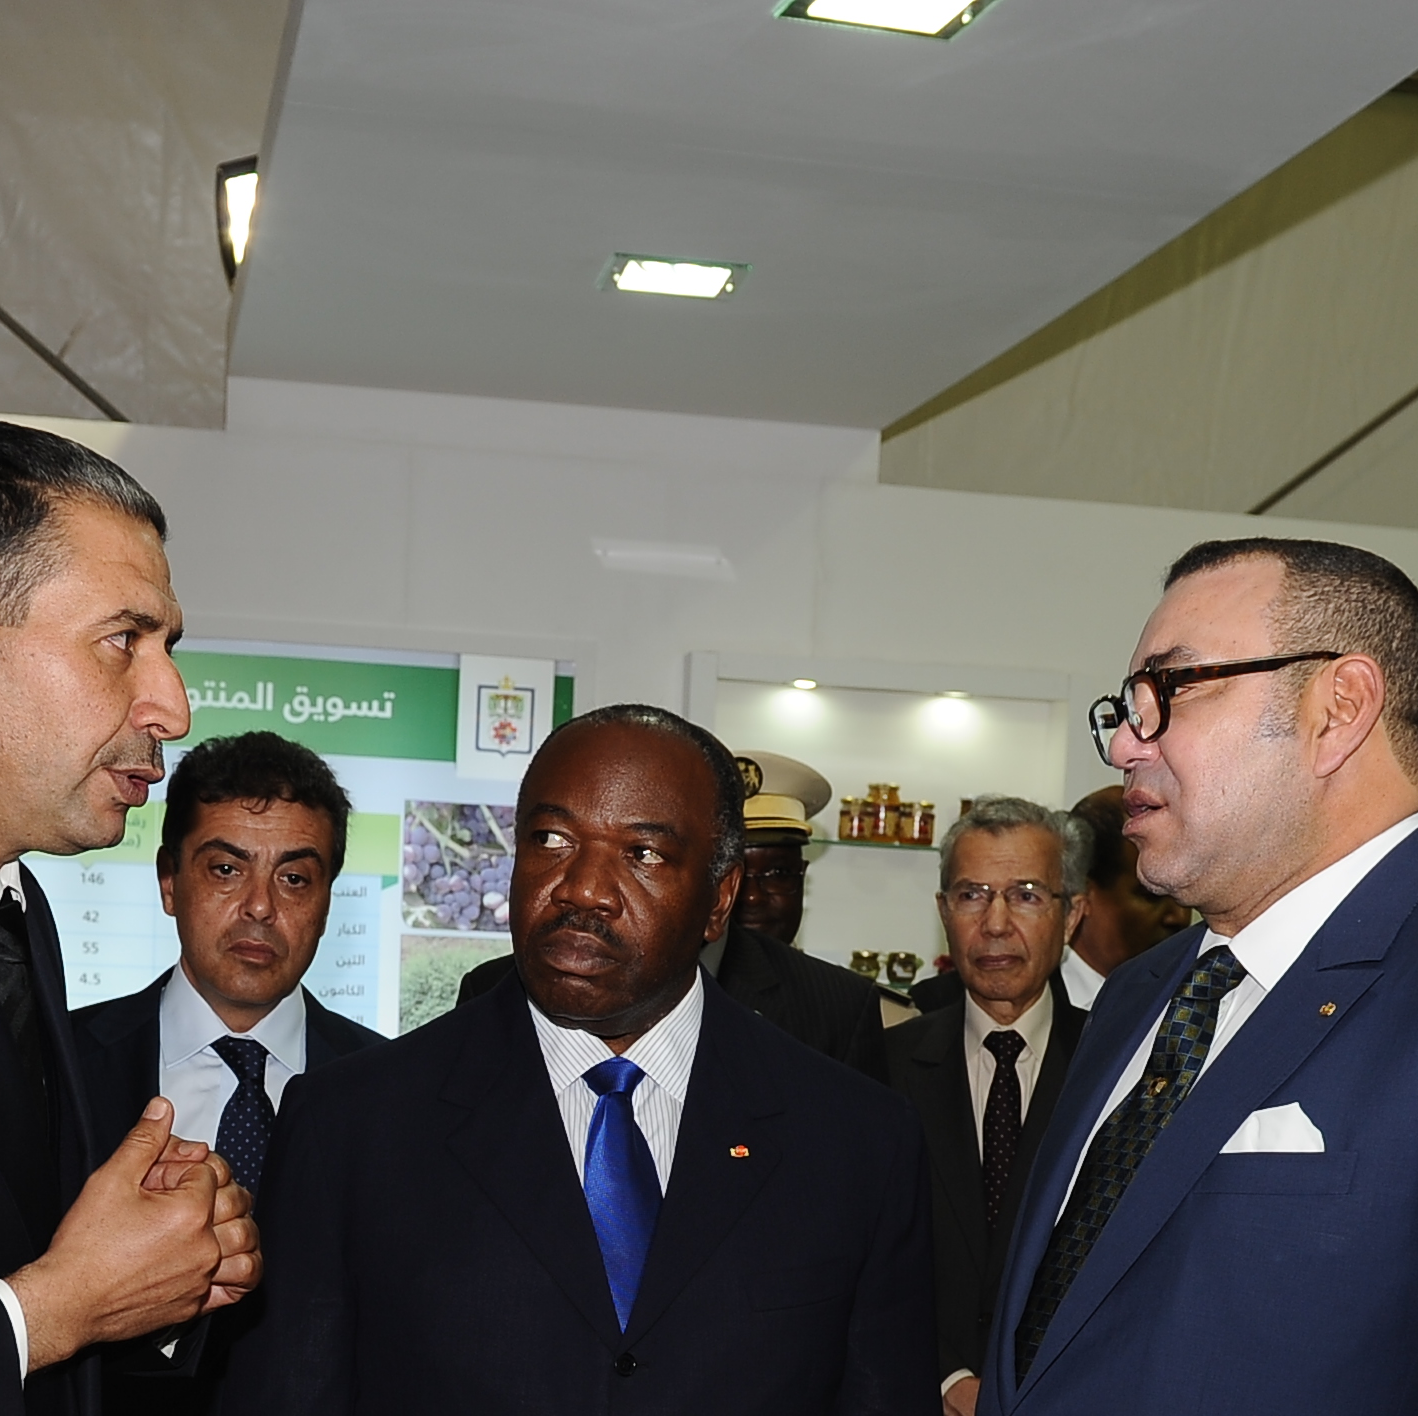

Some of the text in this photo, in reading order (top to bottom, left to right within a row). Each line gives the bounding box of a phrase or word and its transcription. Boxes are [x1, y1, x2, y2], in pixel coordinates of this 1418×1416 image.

[186, 680, 274, 712] المنتو
[283, 686, 395, 724] تسويق
[81, 872, 105, 885] 146
[83, 910, 100, 923] 42
[338, 922, 366, 937] الكبار
[83, 941, 99, 954] 55
[336, 954, 365, 968] التين
[79, 972, 101, 985] 4.5
[319, 984, 364, 998] الكامون
